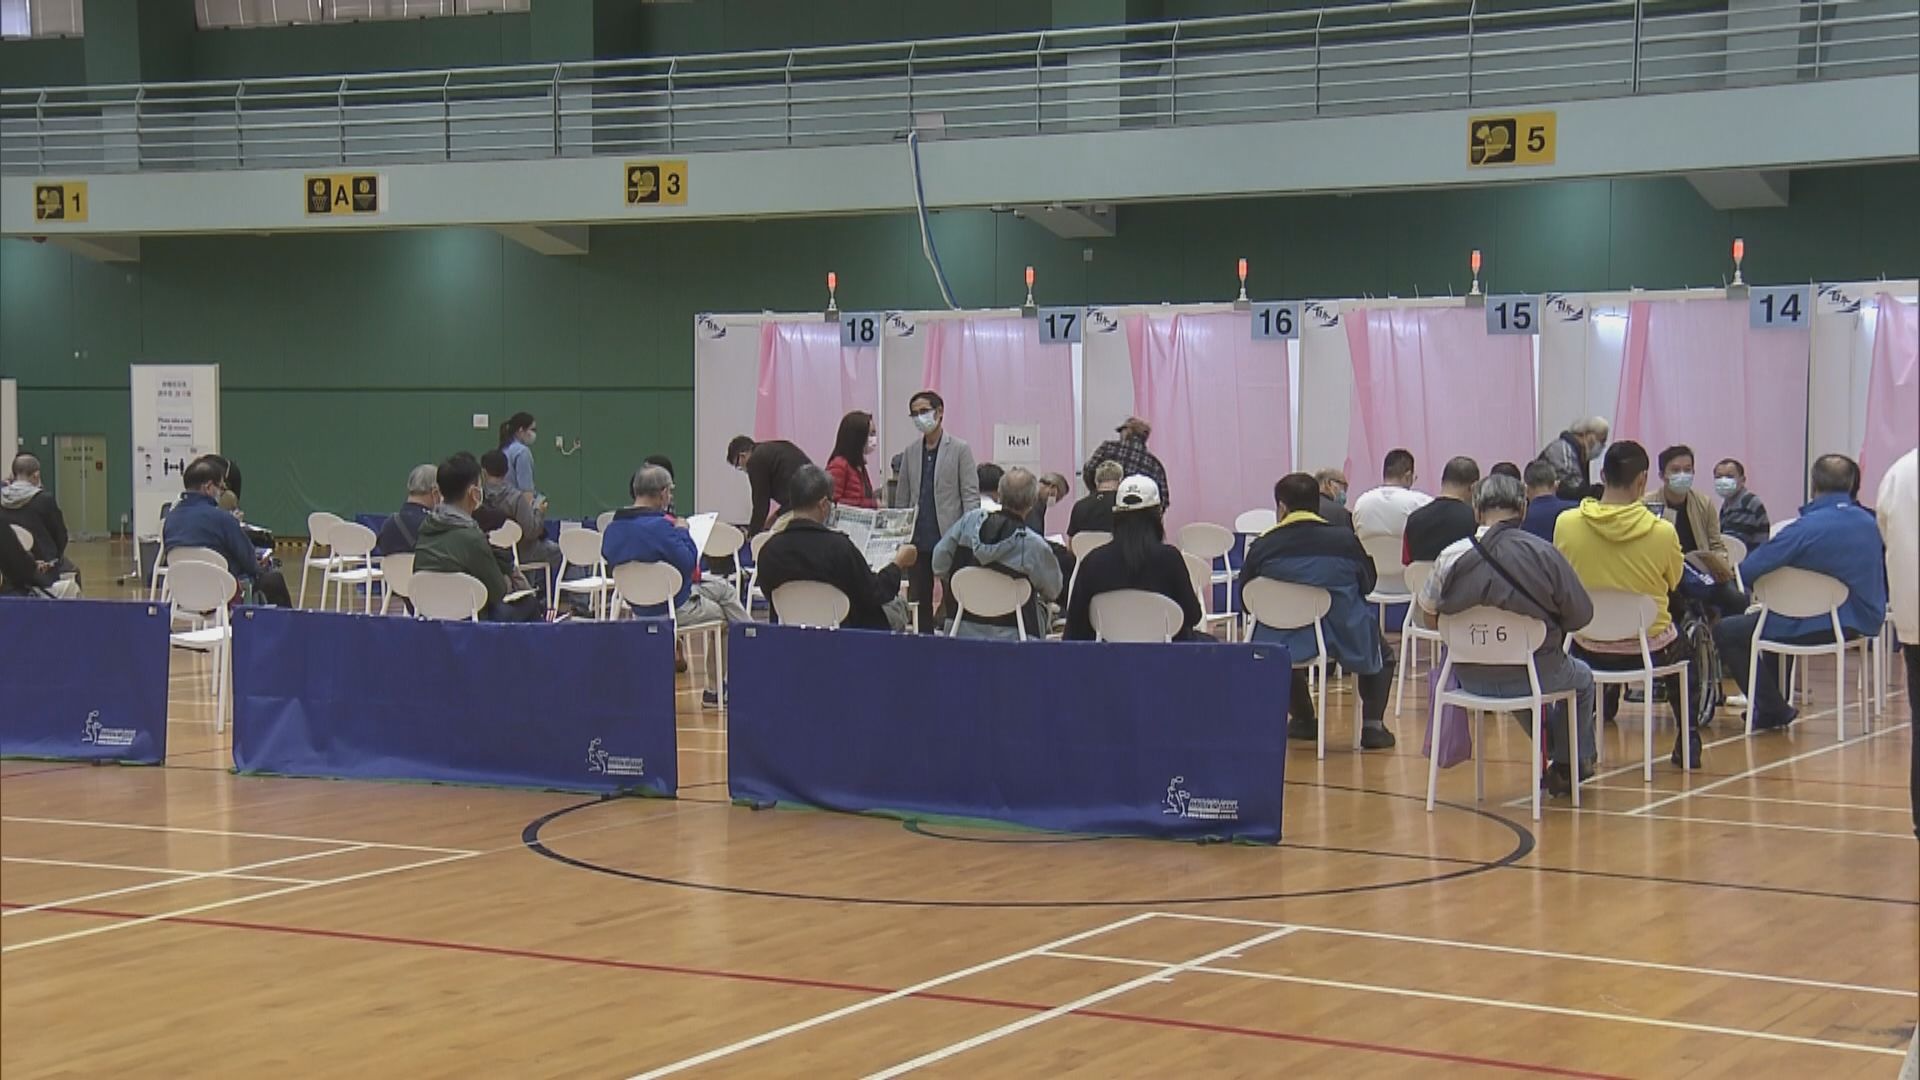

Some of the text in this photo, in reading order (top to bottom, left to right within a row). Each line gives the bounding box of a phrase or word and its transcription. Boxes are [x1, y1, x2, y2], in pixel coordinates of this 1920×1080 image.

[1527, 126, 1546, 153] 5
[334, 184, 350, 206] A
[667, 173, 681, 195] 3
[71, 192, 81, 213] 1
[1494, 302, 1532, 330] 15
[1759, 293, 1801, 323] 14
[846, 317, 875, 342] 18
[1045, 313, 1076, 339] 17
[1259, 308, 1293, 335] 16
[1008, 435, 1030, 446] Rest
[1469, 624, 1508, 646] 行 6
